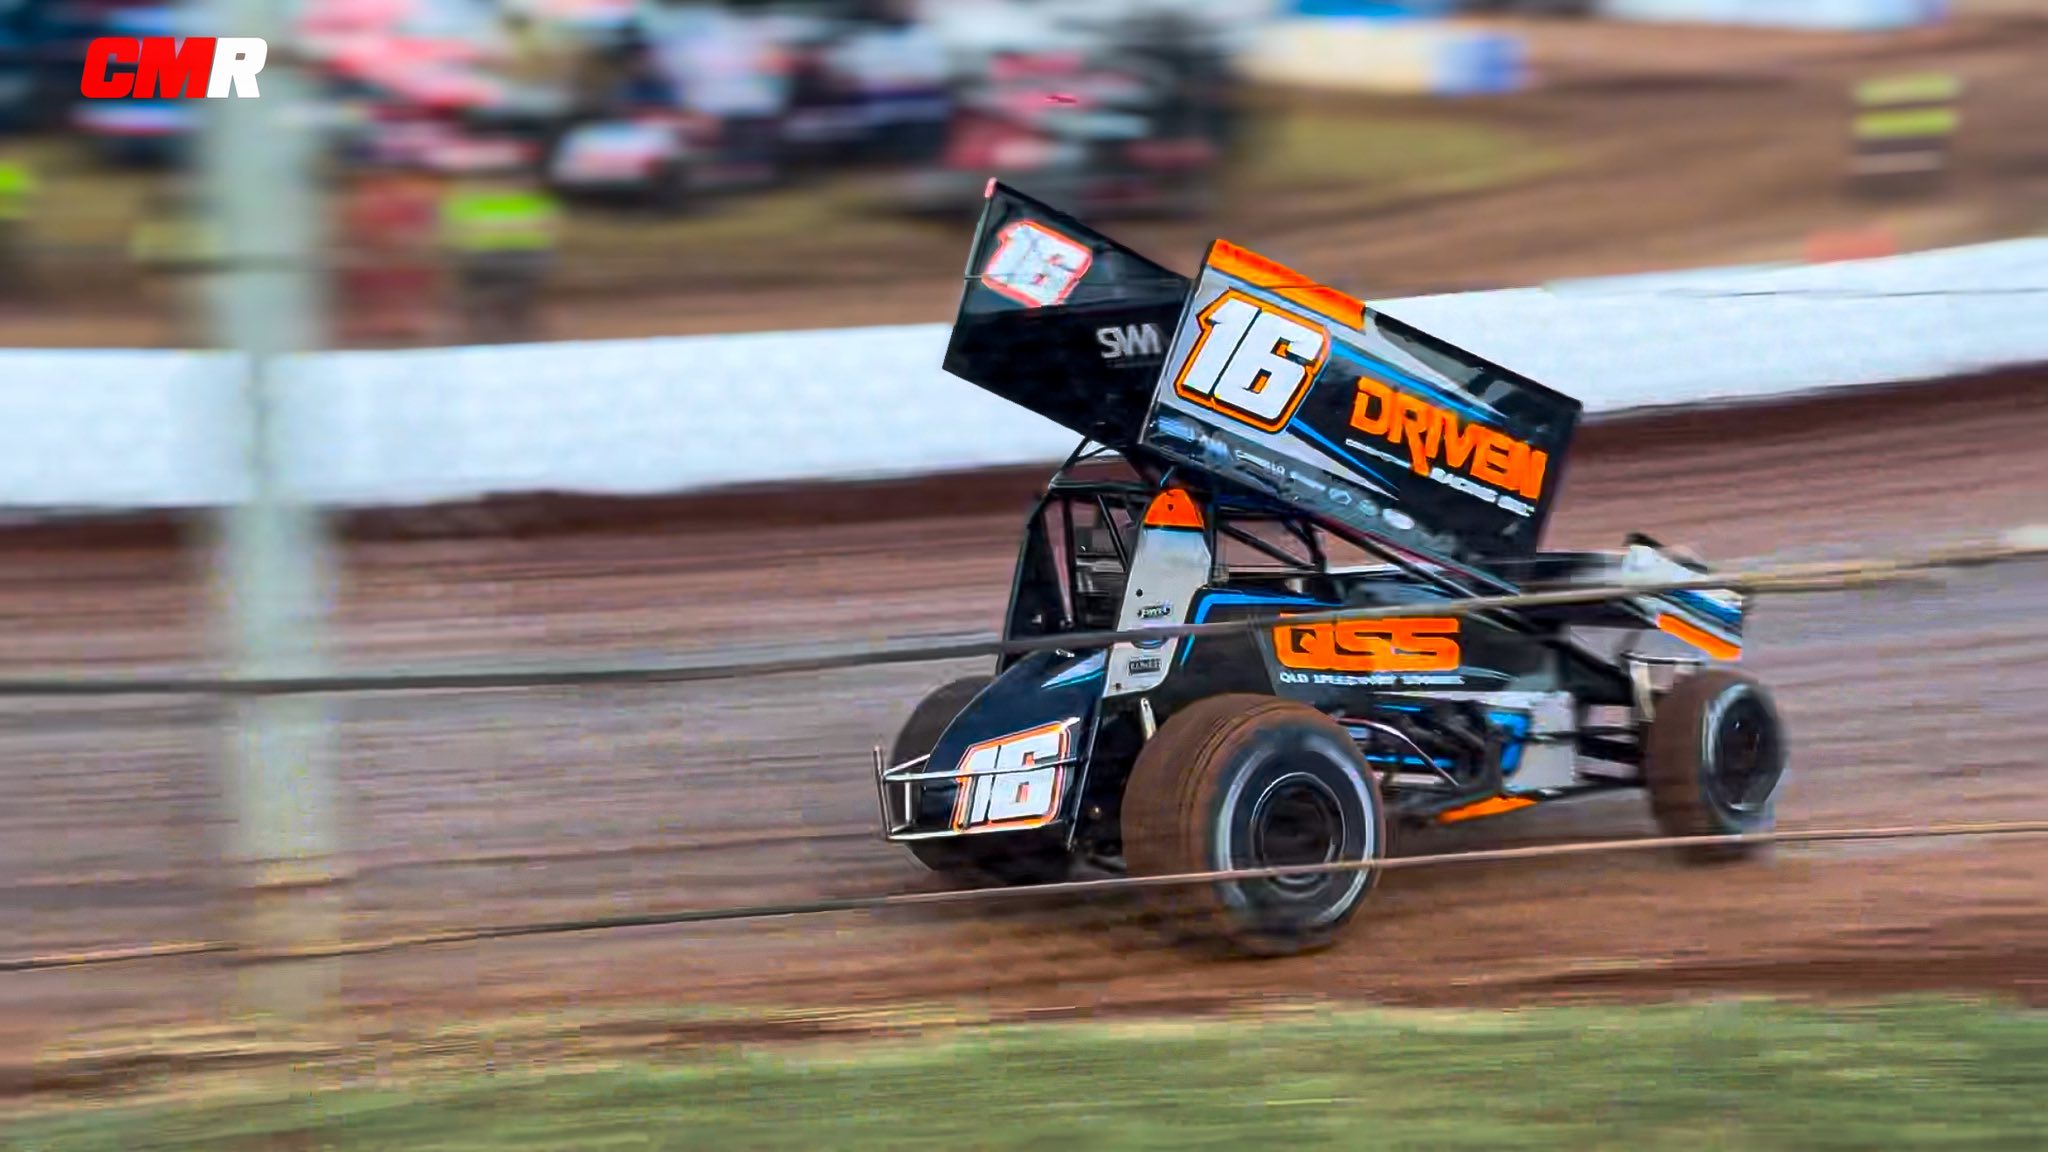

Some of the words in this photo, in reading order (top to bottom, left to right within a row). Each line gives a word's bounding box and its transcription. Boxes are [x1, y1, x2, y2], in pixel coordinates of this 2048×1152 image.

[984, 221, 1091, 307] 16
[1179, 293, 1329, 427] 16
[1349, 376, 1548, 499] DRIVEN
[1272, 613, 1460, 672] QSS
[956, 727, 1065, 828] 16
